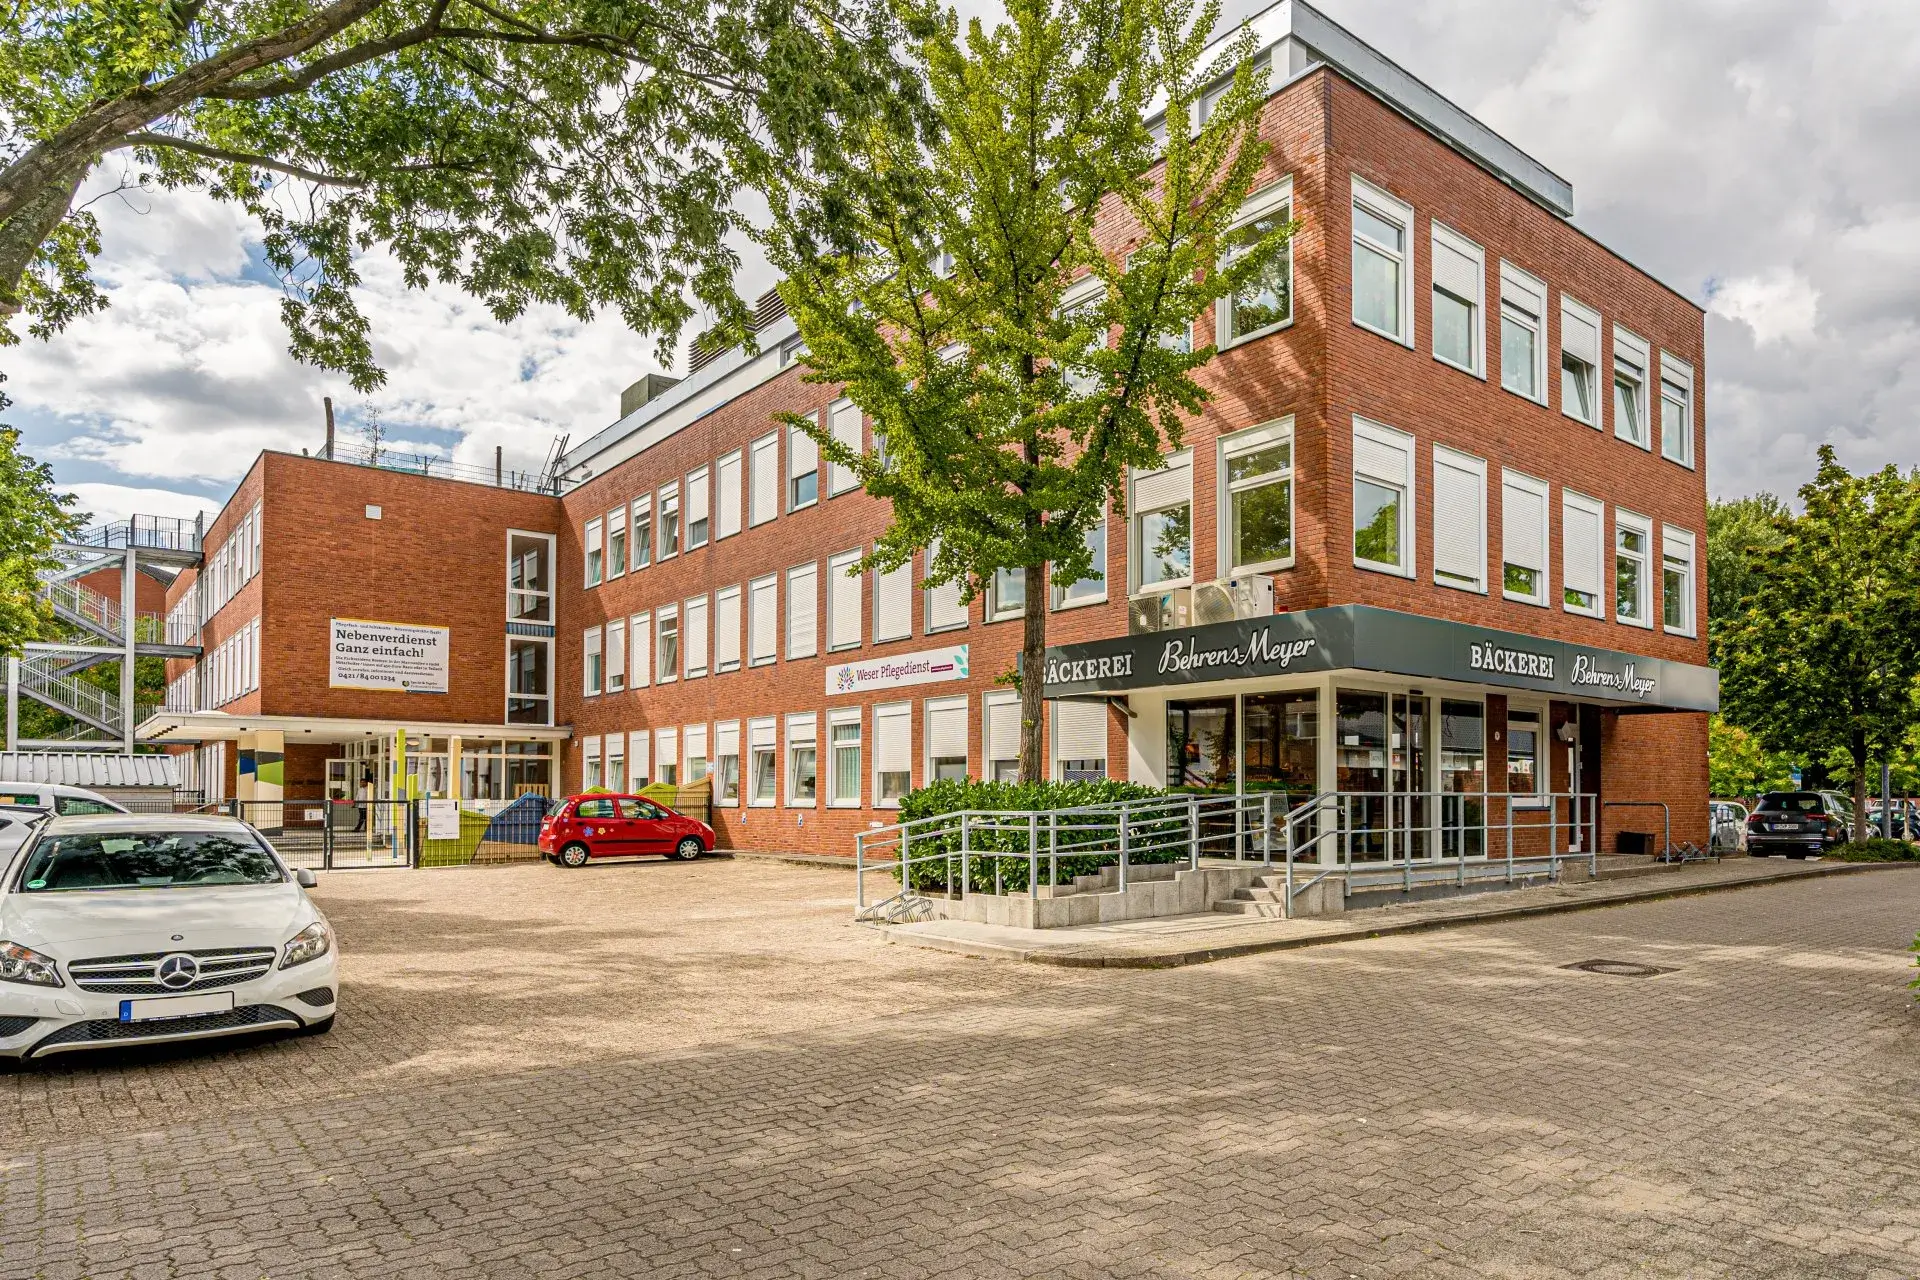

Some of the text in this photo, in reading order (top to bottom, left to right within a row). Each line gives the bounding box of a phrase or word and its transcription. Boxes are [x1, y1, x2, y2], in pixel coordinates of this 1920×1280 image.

[336, 630, 437, 646] Nebenverdienst
[336, 643, 424, 657] Ganz einfach!
[1158, 626, 1315, 674] Behrens-Meyer
[856, 669, 879, 682] Weser
[881, 660, 930, 680] Pflegedienst
[1470, 641, 1655, 698] BÄCKEREI Behrens-Meyer
